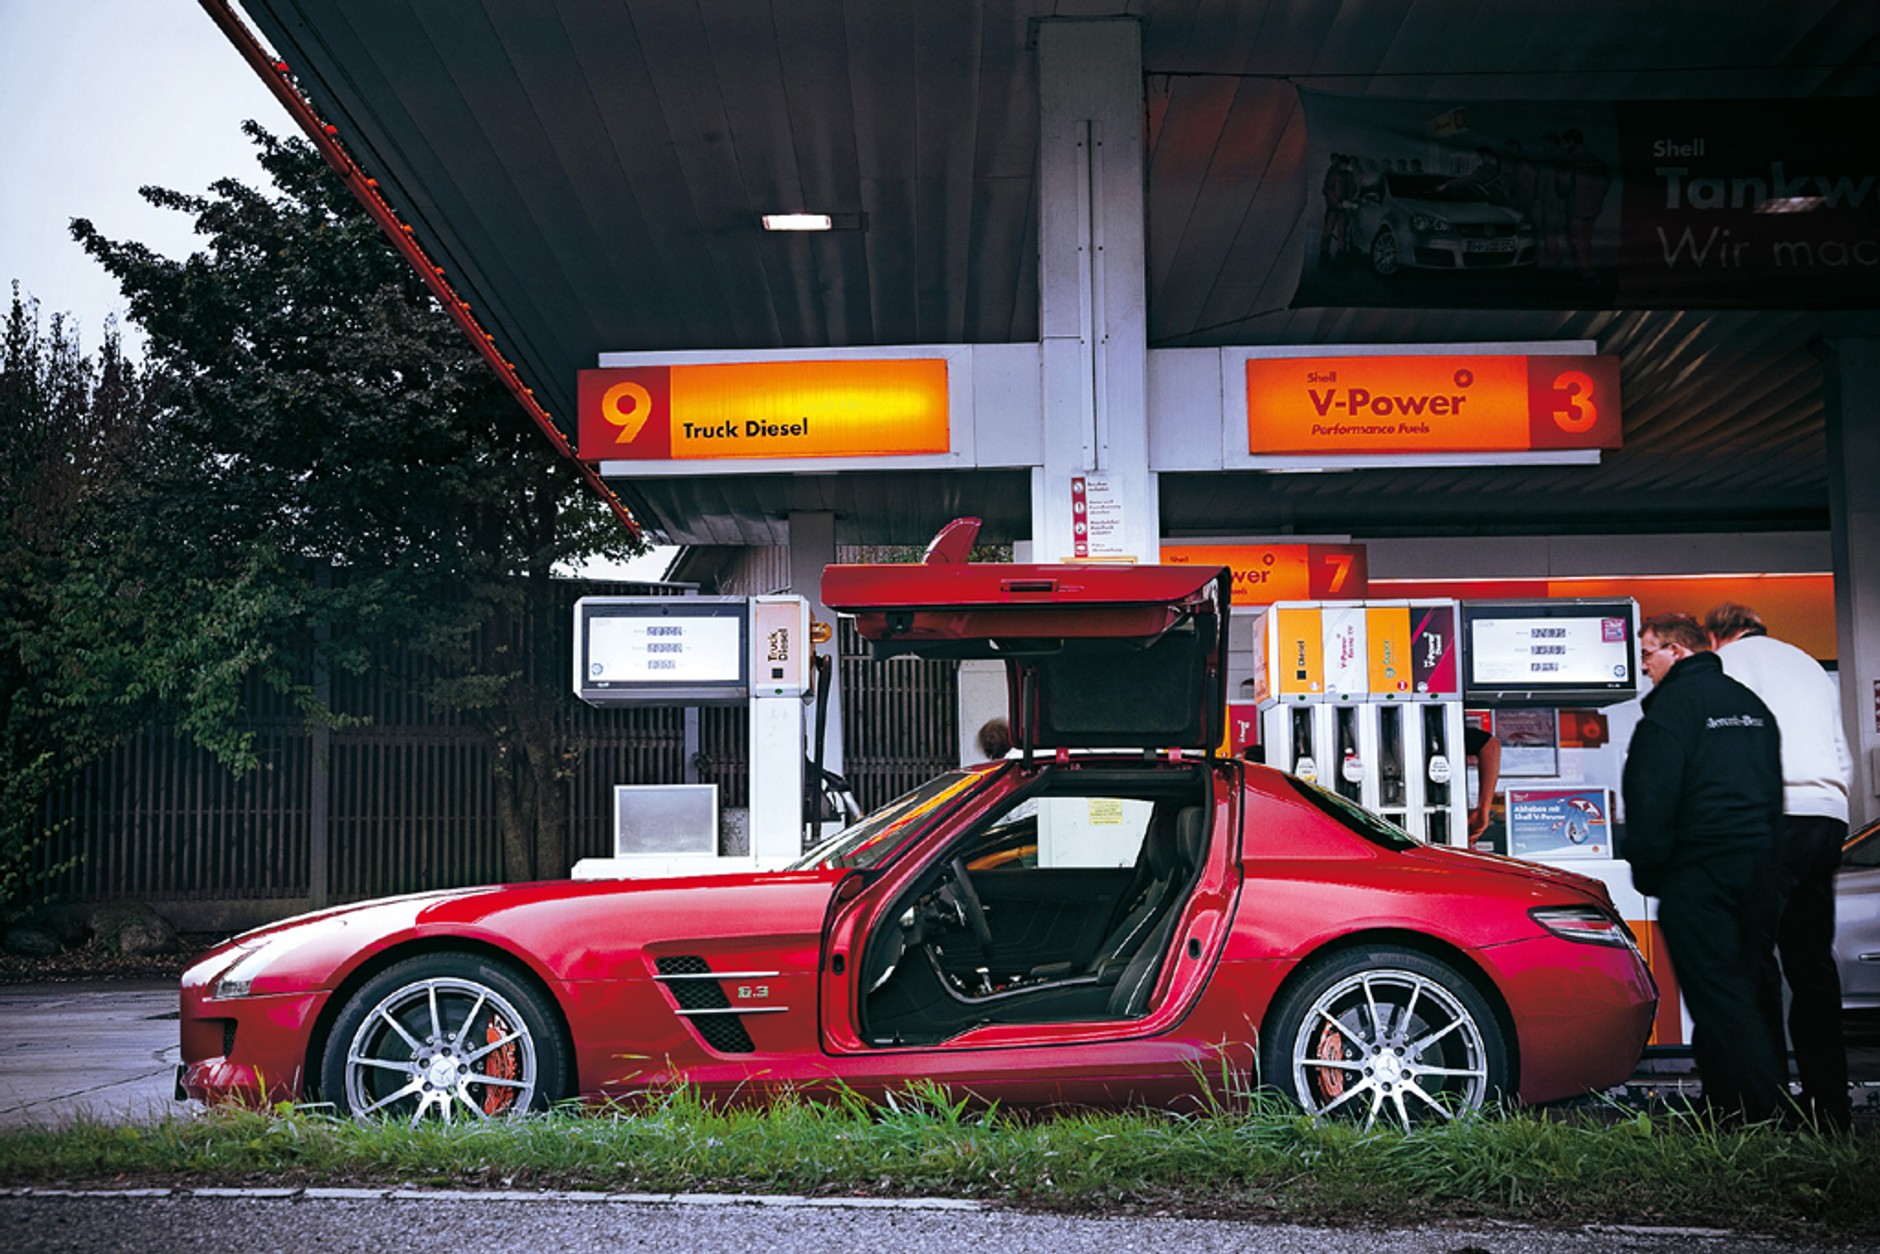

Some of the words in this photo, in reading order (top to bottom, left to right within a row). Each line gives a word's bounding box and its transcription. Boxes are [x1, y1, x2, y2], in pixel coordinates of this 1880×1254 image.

[1653, 137, 1705, 157] Shell
[1655, 161, 1880, 210] Tankw
[1656, 226, 1750, 268] Wir
[1307, 371, 1337, 383] Shell
[602, 381, 652, 443] 9
[1308, 388, 1466, 416] V-Power
[1552, 370, 1597, 433] 3
[683, 420, 739, 439] Truck
[746, 417, 808, 437] Diesel
[1311, 422, 1395, 435] Performance
[1398, 422, 1430, 434] Fuels
[1325, 554, 1355, 593] 7
[767, 631, 778, 662] Truck
[778, 628, 789, 661] Diesel
